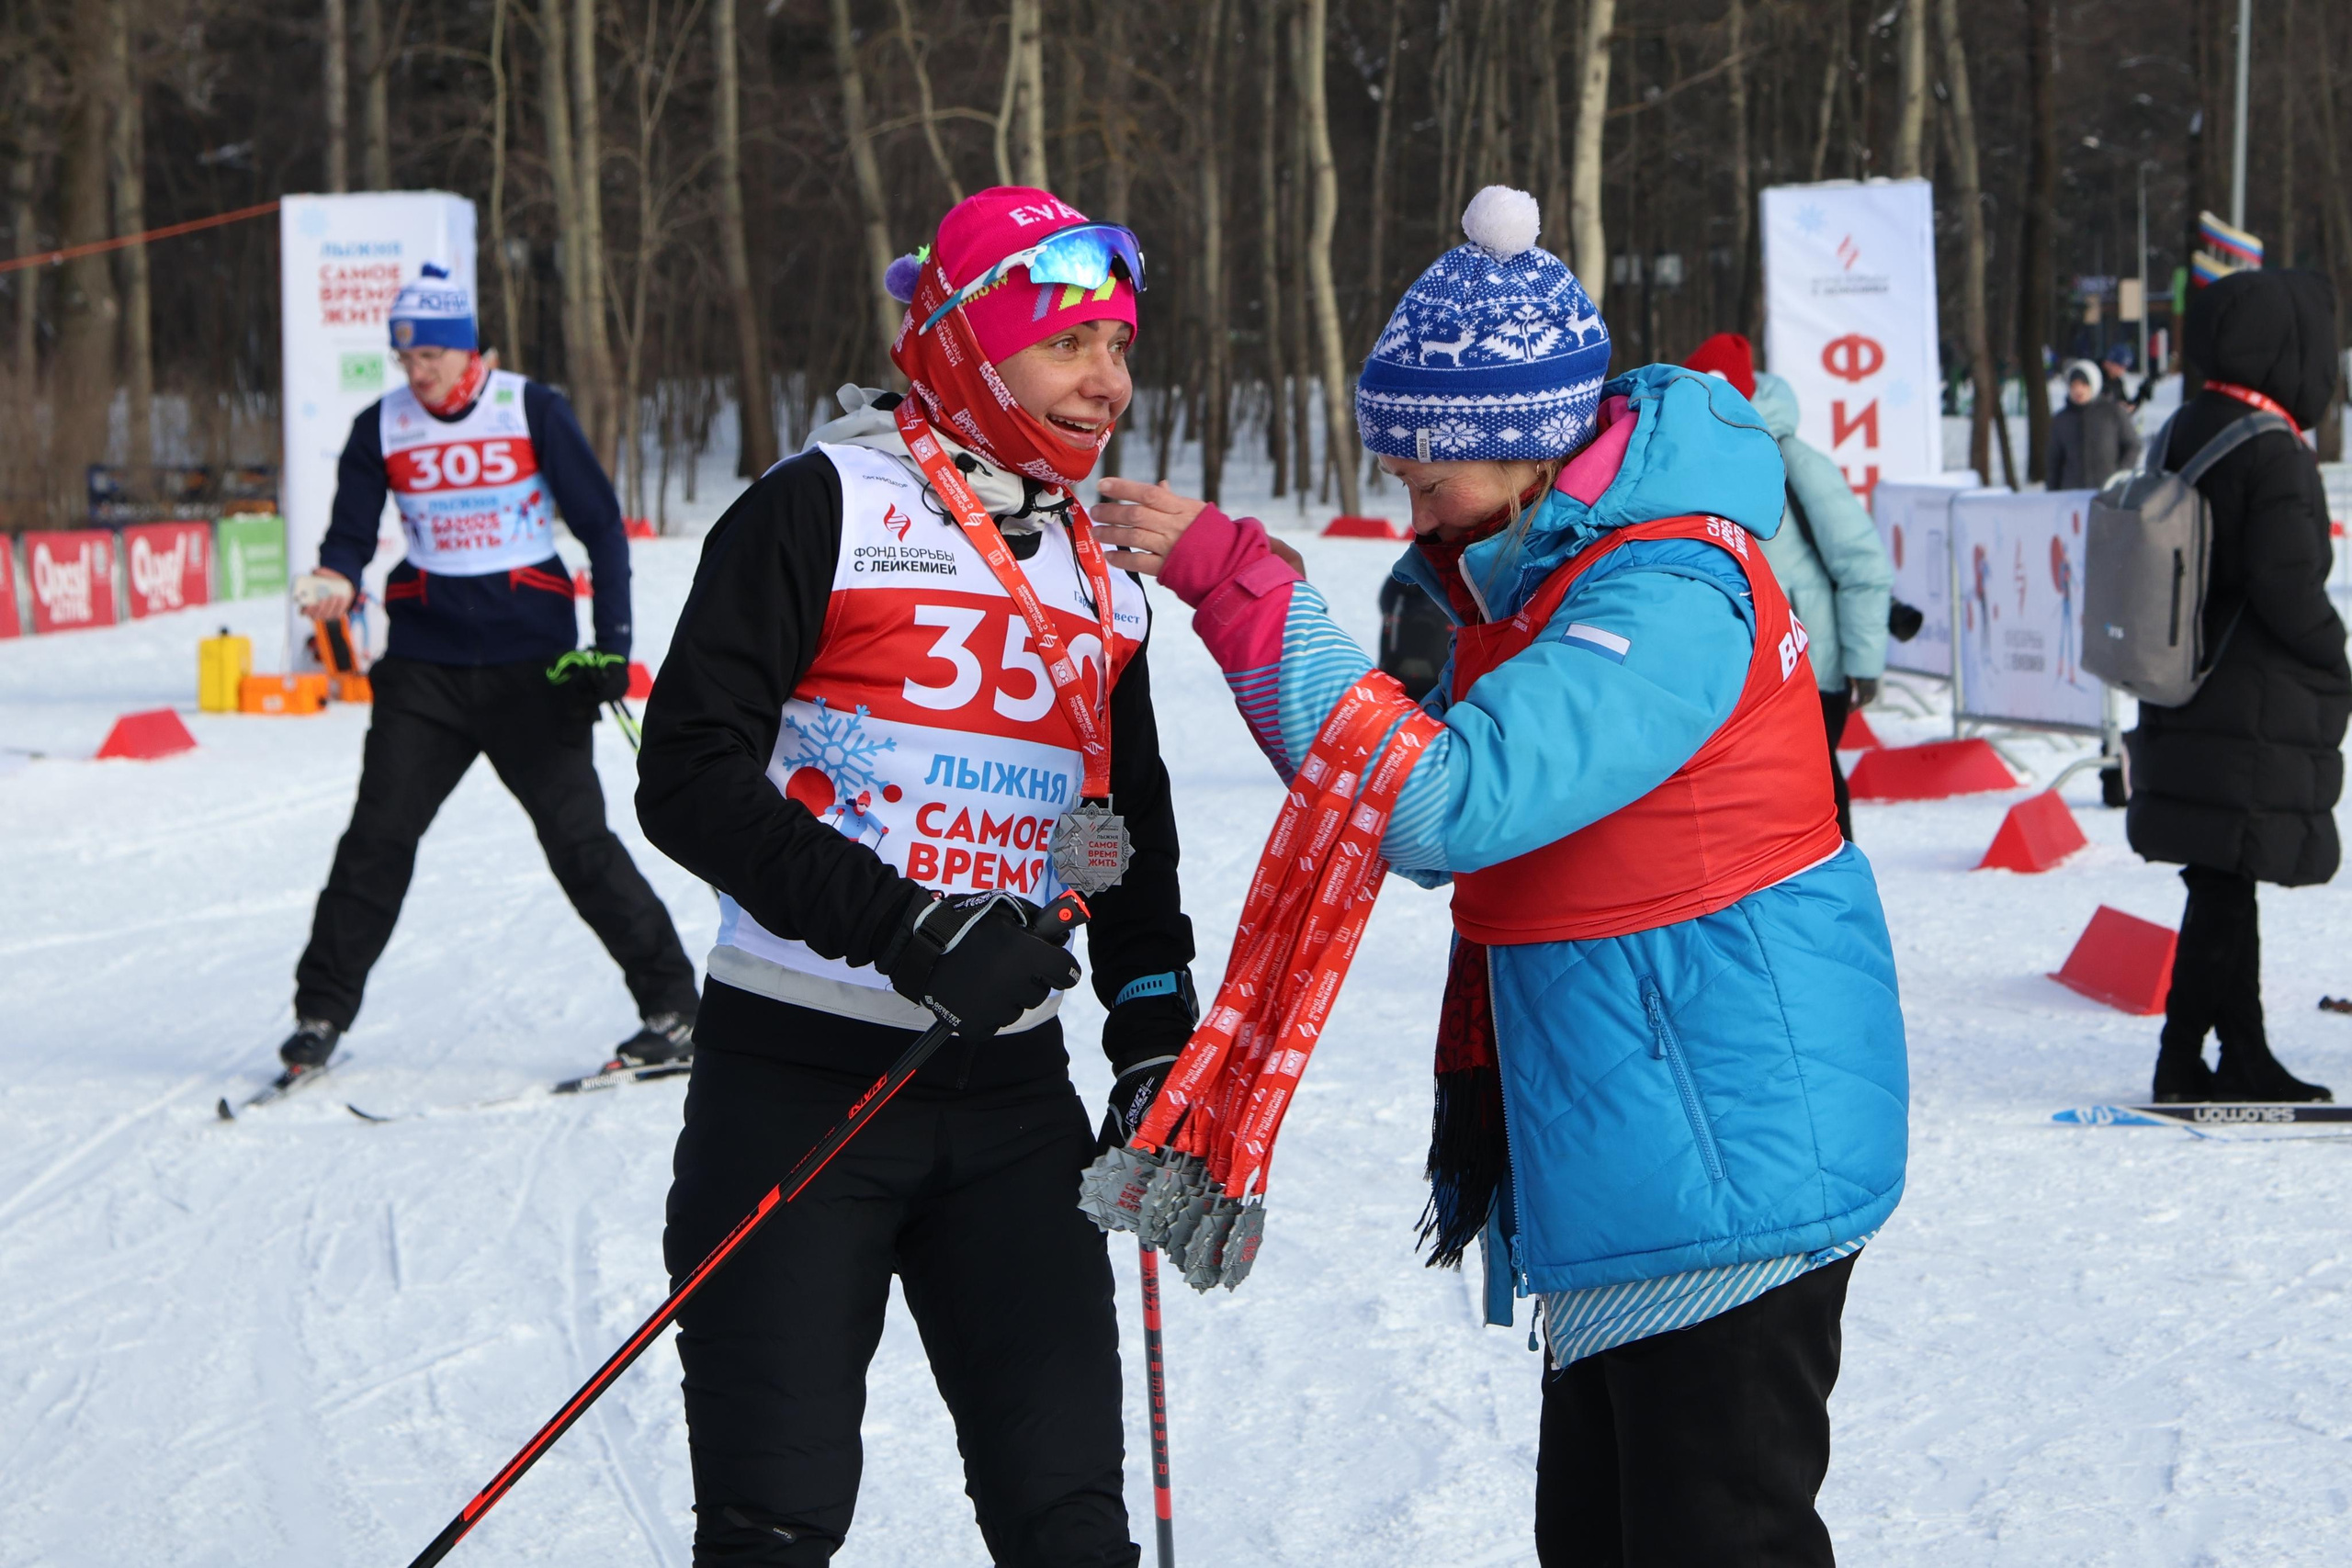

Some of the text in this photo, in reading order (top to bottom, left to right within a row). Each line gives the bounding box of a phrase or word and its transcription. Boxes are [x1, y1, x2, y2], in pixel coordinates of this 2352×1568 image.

[324, 308, 393, 323] ЖИТ
[408, 441, 517, 491] 305
[935, 470, 967, 513] ФОНД БОРЬБЫ
[854, 547, 955, 563] ФОНД БОРЬБЫ
[854, 558, 957, 576] С ЛЕЙКЕМИЕЙ
[1016, 587, 1044, 633] ФОНД БОРЬБЫ
[902, 604, 1103, 722] 350
[1069, 697, 1091, 739] ФОНД БОРЬБЫ
[924, 753, 1068, 805] ЛЫЖНЯ
[915, 802, 1055, 852] САМОЕ
[1088, 840, 1118, 849] САМОЕ
[906, 841, 1045, 895] ВРЕМЯ
[1088, 850, 1118, 858] ВРЕМЯ
[1088, 859, 1117, 867] ЖИТЬ
[933, 1001, 962, 1024] GORE-TEX
[1150, 1343, 1169, 1475] TEMPESTA
